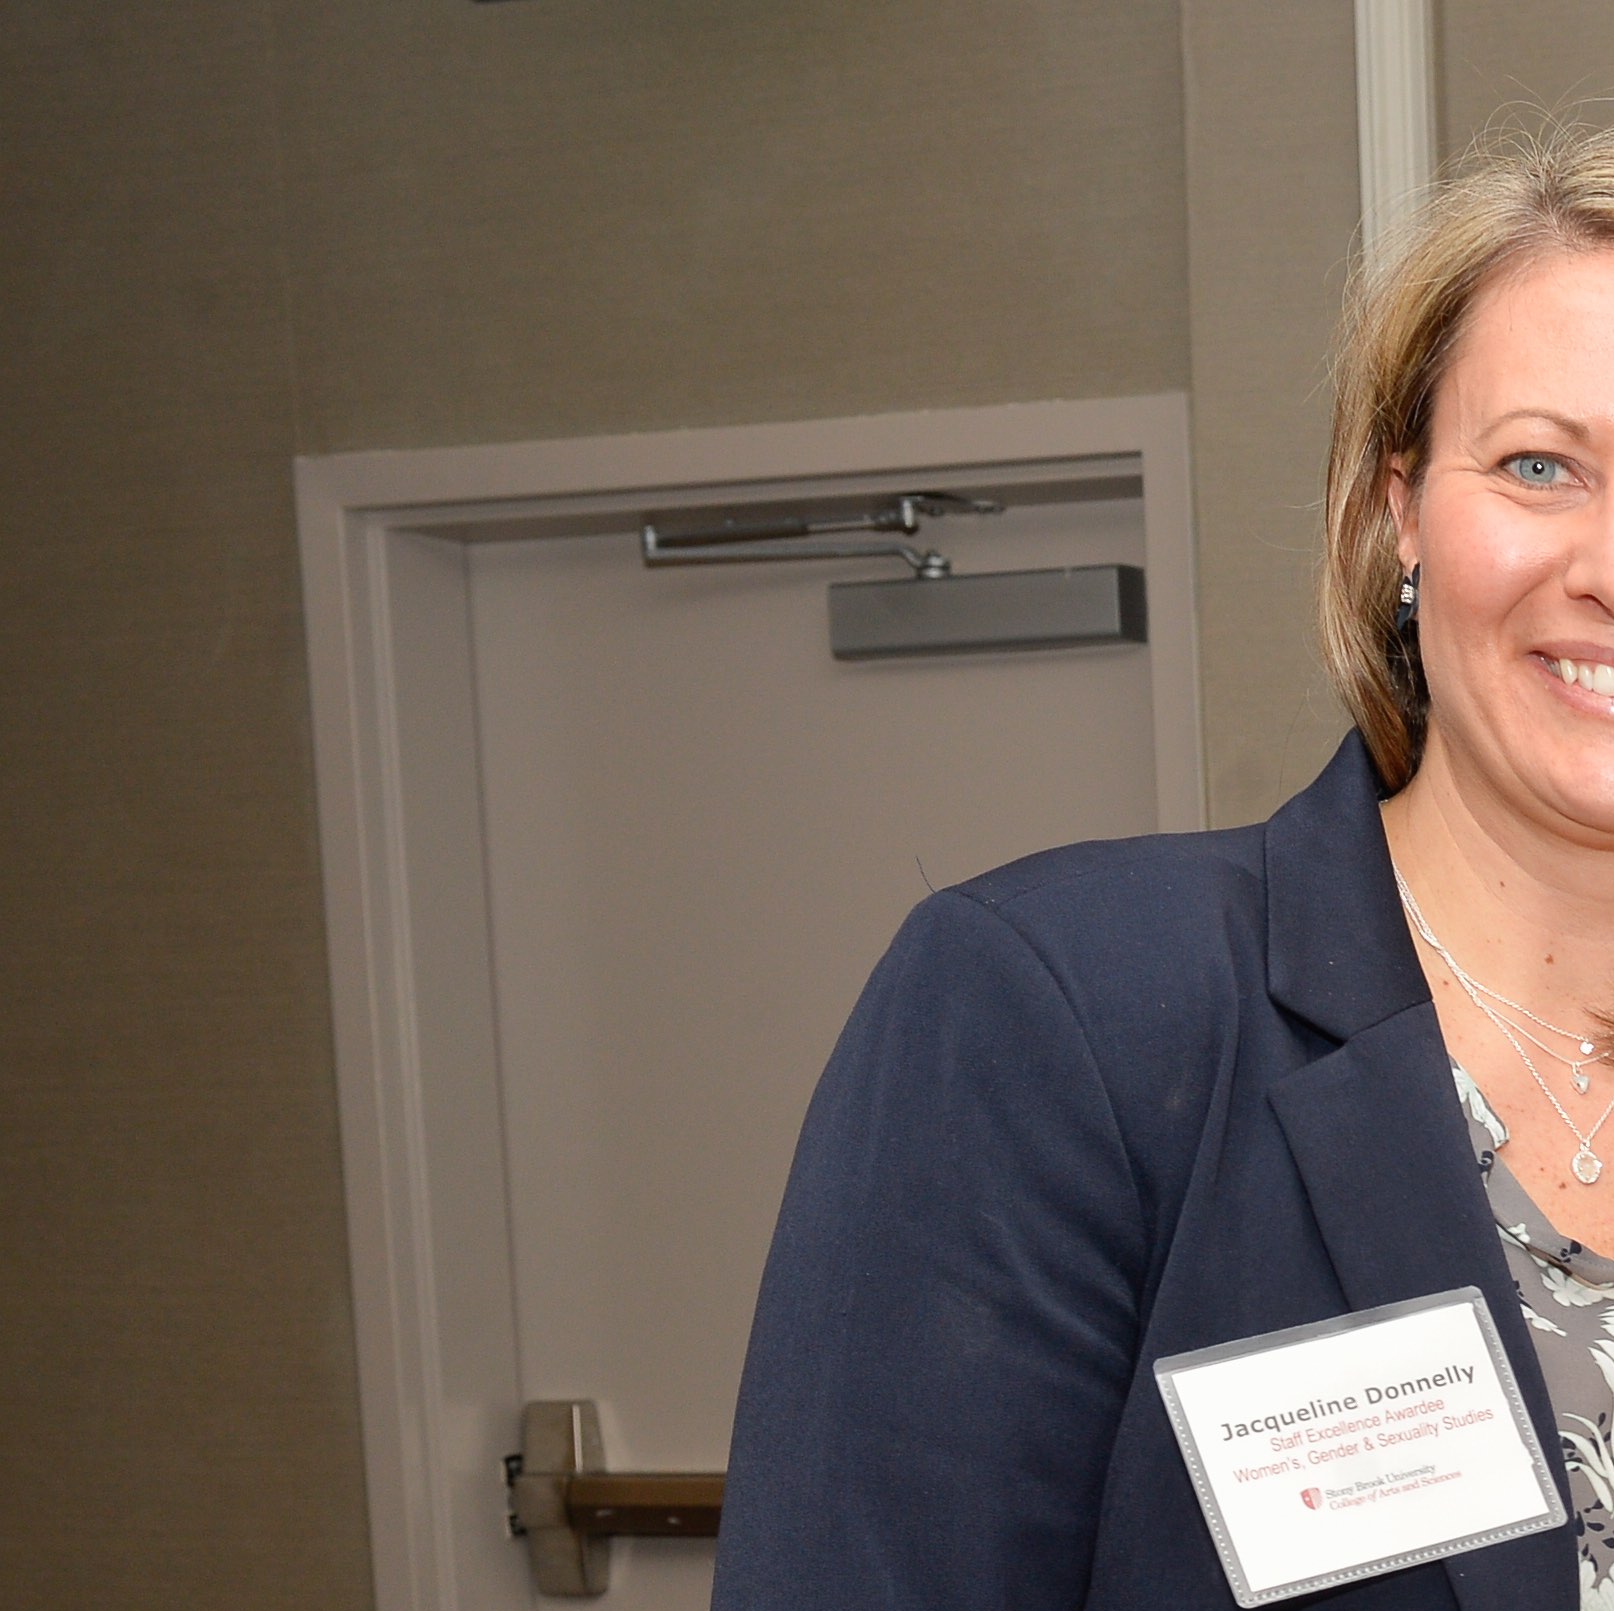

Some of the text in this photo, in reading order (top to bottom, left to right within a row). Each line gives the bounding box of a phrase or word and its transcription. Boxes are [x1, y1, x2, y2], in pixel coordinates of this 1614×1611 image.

[1220, 1365, 1474, 1442] Jacqueline Donnelly
[1270, 1399, 1445, 1453] Staff Excellence Awardee
[1232, 1408, 1494, 1484] Women's, Gender & Sexuality Studies
[1325, 1464, 1436, 1500] Stony Brook University
[1329, 1471, 1462, 1511] College of Arts and Sciences
